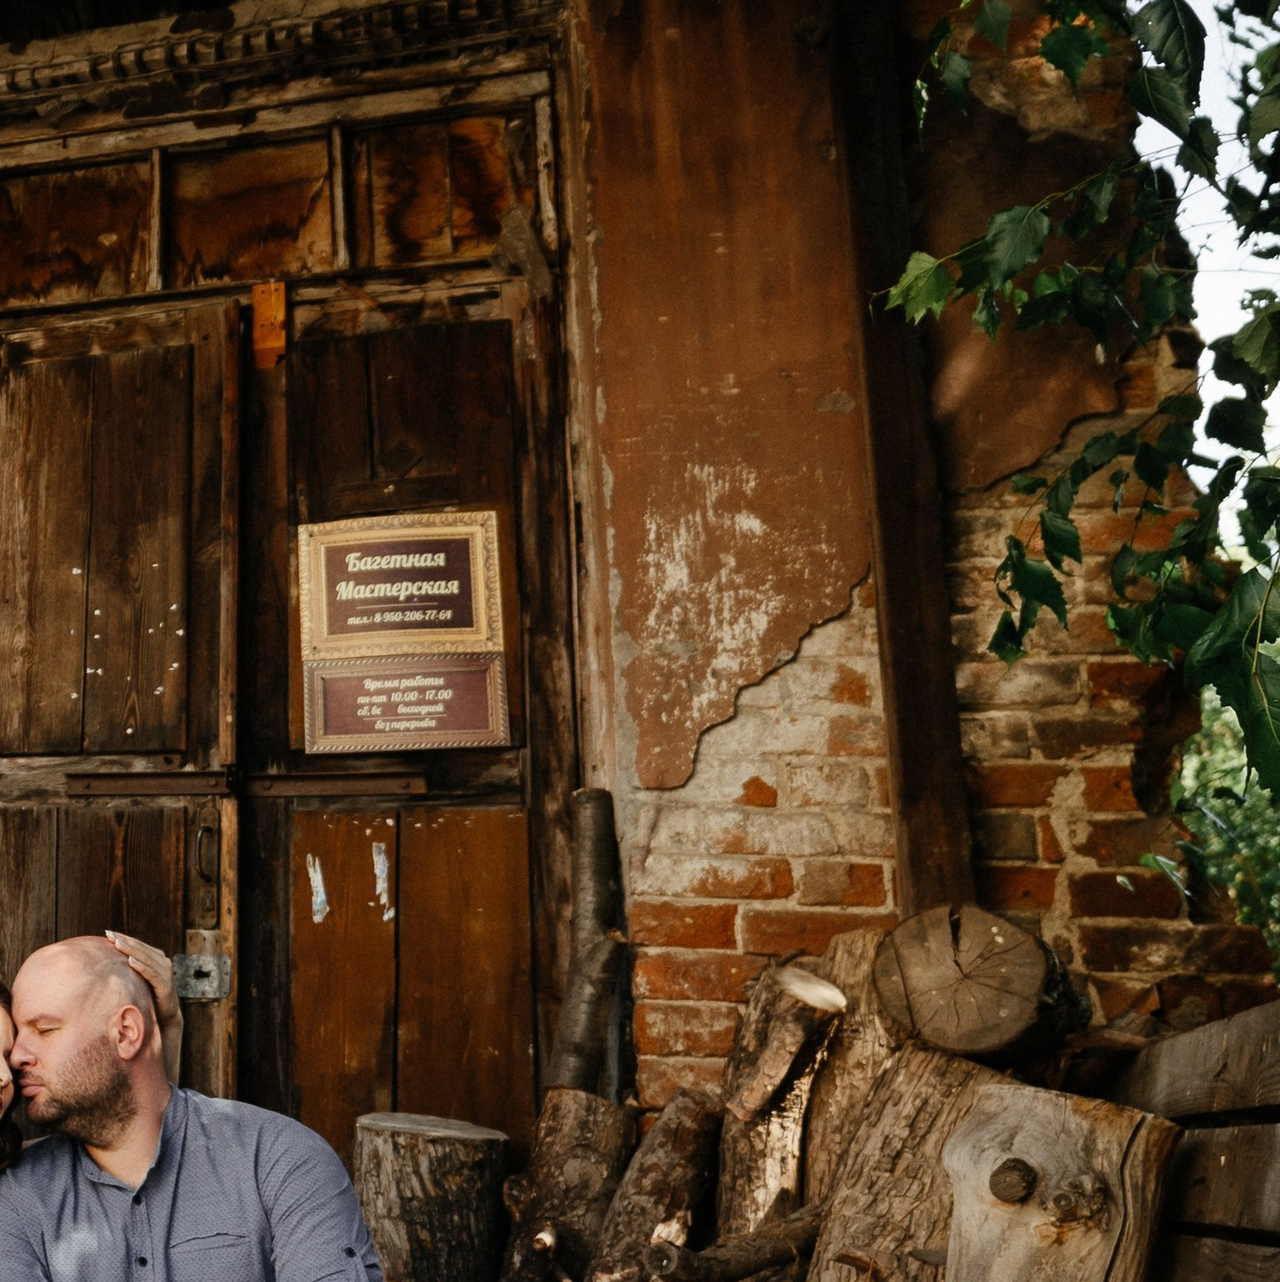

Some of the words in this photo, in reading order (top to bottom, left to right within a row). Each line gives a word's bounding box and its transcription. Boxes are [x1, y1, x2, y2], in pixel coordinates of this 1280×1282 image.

[345, 551, 446, 572] Багетная
[336, 580, 460, 602] Мастерская
[347, 616, 373, 626] тел.:
[374, 609, 453, 623] 8-950-206-77-64
[363, 678, 399, 691] Время
[400, 675, 444, 689] работы
[357, 695, 386, 705] пн-пт
[391, 691, 418, 702] 10.00
[425, 689, 452, 700] 17.00
[397, 703, 444, 716] выходной
[374, 719, 390, 731] без
[390, 717, 436, 731] перерыва
